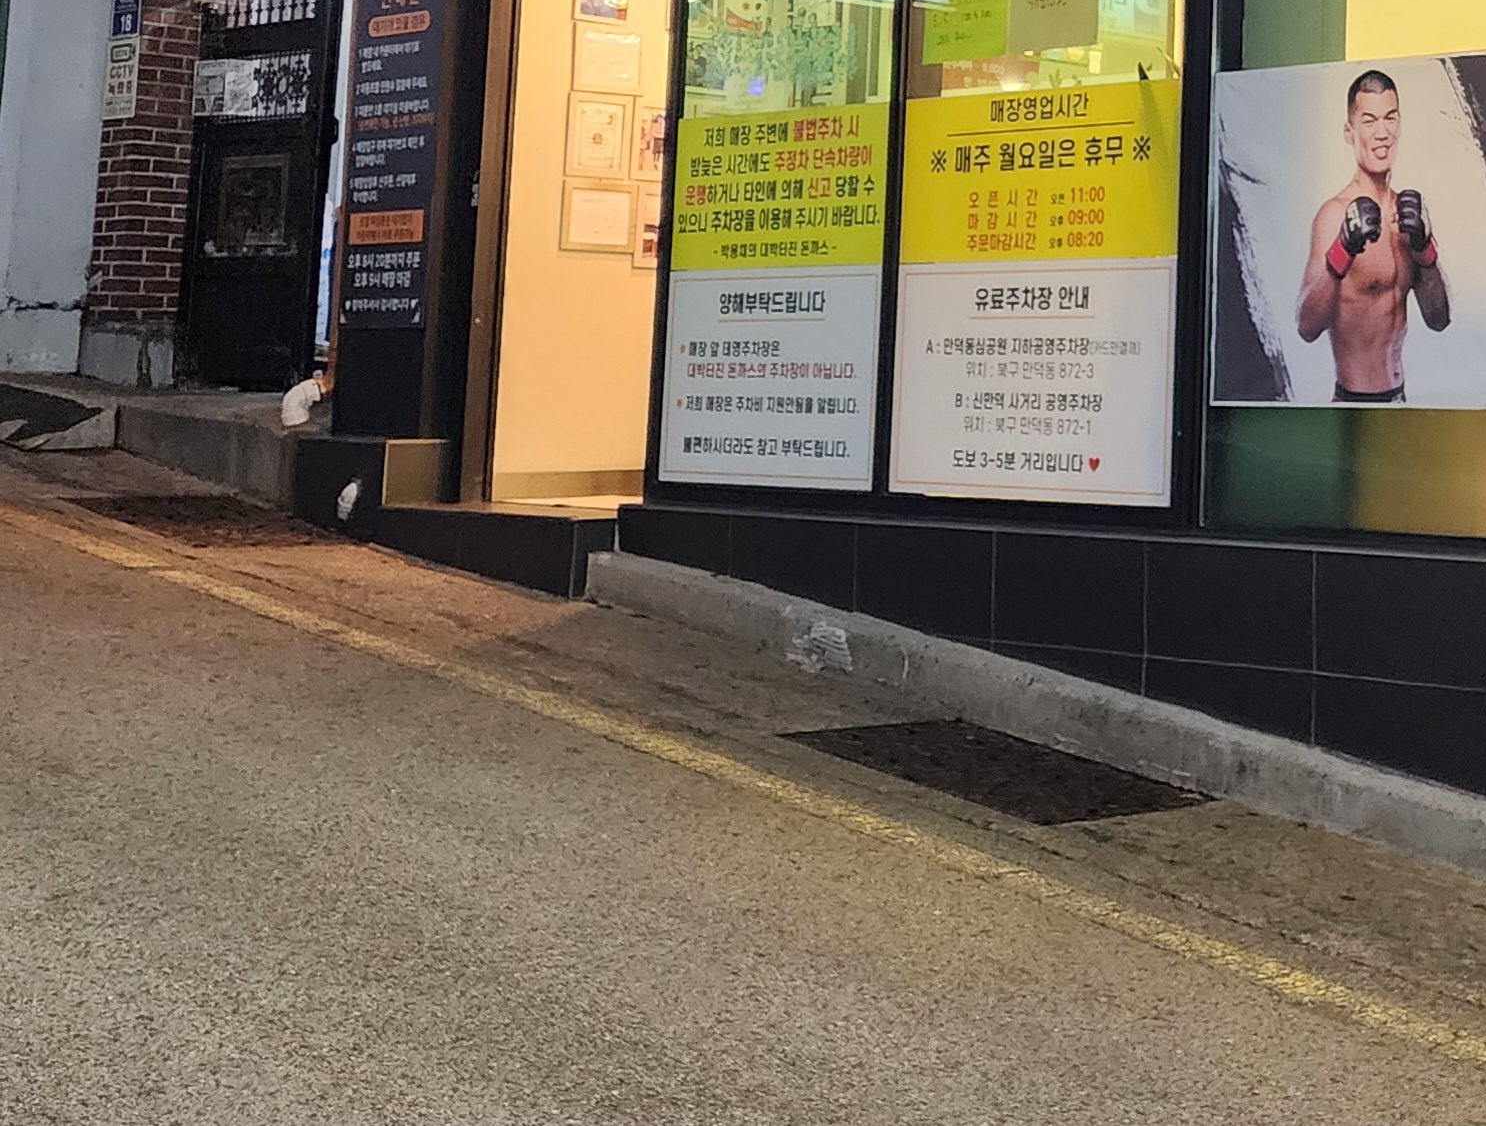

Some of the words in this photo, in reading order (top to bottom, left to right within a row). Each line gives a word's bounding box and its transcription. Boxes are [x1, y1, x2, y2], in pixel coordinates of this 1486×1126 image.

[120, 14, 132, 32] 18
[110, 65, 134, 79] CCTV
[991, 93, 1089, 123] 매장영업시간
[704, 127, 725, 148] 저희
[730, 125, 750, 145] 매장
[756, 122, 789, 144] 주변에
[793, 116, 842, 142] 불법주차
[847, 115, 859, 137] 시
[691, 155, 723, 177] 밤늦은
[726, 152, 770, 175] 시간에도
[775, 149, 809, 172] 주정차
[813, 145, 872, 169] 단속차량이
[955, 144, 991, 173] 매주
[999, 139, 1076, 171] 월요일은
[1084, 136, 1123, 167] 휴무
[685, 183, 739, 206] 운행하거나
[744, 181, 776, 202] 타인에
[781, 179, 803, 200] 의해
[807, 177, 830, 199] 신고
[835, 175, 859, 197] 당할
[863, 175, 875, 196] 수
[1070, 186, 1105, 203] 11:00
[678, 213, 708, 233] 있으니
[711, 208, 755, 233] 주차장을
[759, 208, 792, 230] 이용해
[795, 206, 828, 230] 주시기
[832, 204, 880, 227] 바랍니다.
[1068, 209, 1104, 225] 09:00
[968, 233, 1036, 252] 주문마감시간
[1067, 231, 1103, 248] 08:20
[720, 291, 825, 314] 양해부탁드립니다
[975, 287, 1052, 312] 유료주차장
[1058, 286, 1089, 310] 안내
[1059, 363, 1094, 379] 872-3
[1008, 392, 1041, 411] 사거리
[1046, 393, 1103, 412] 공영주차장
[1057, 419, 1091, 435] 872-1
[757, 438, 777, 455] 참고
[782, 439, 850, 458] 부탁드립니다.
[953, 450, 976, 468] 도보
[980, 451, 1015, 470] 3-5분
[1021, 451, 1083, 472] 거리입니다
